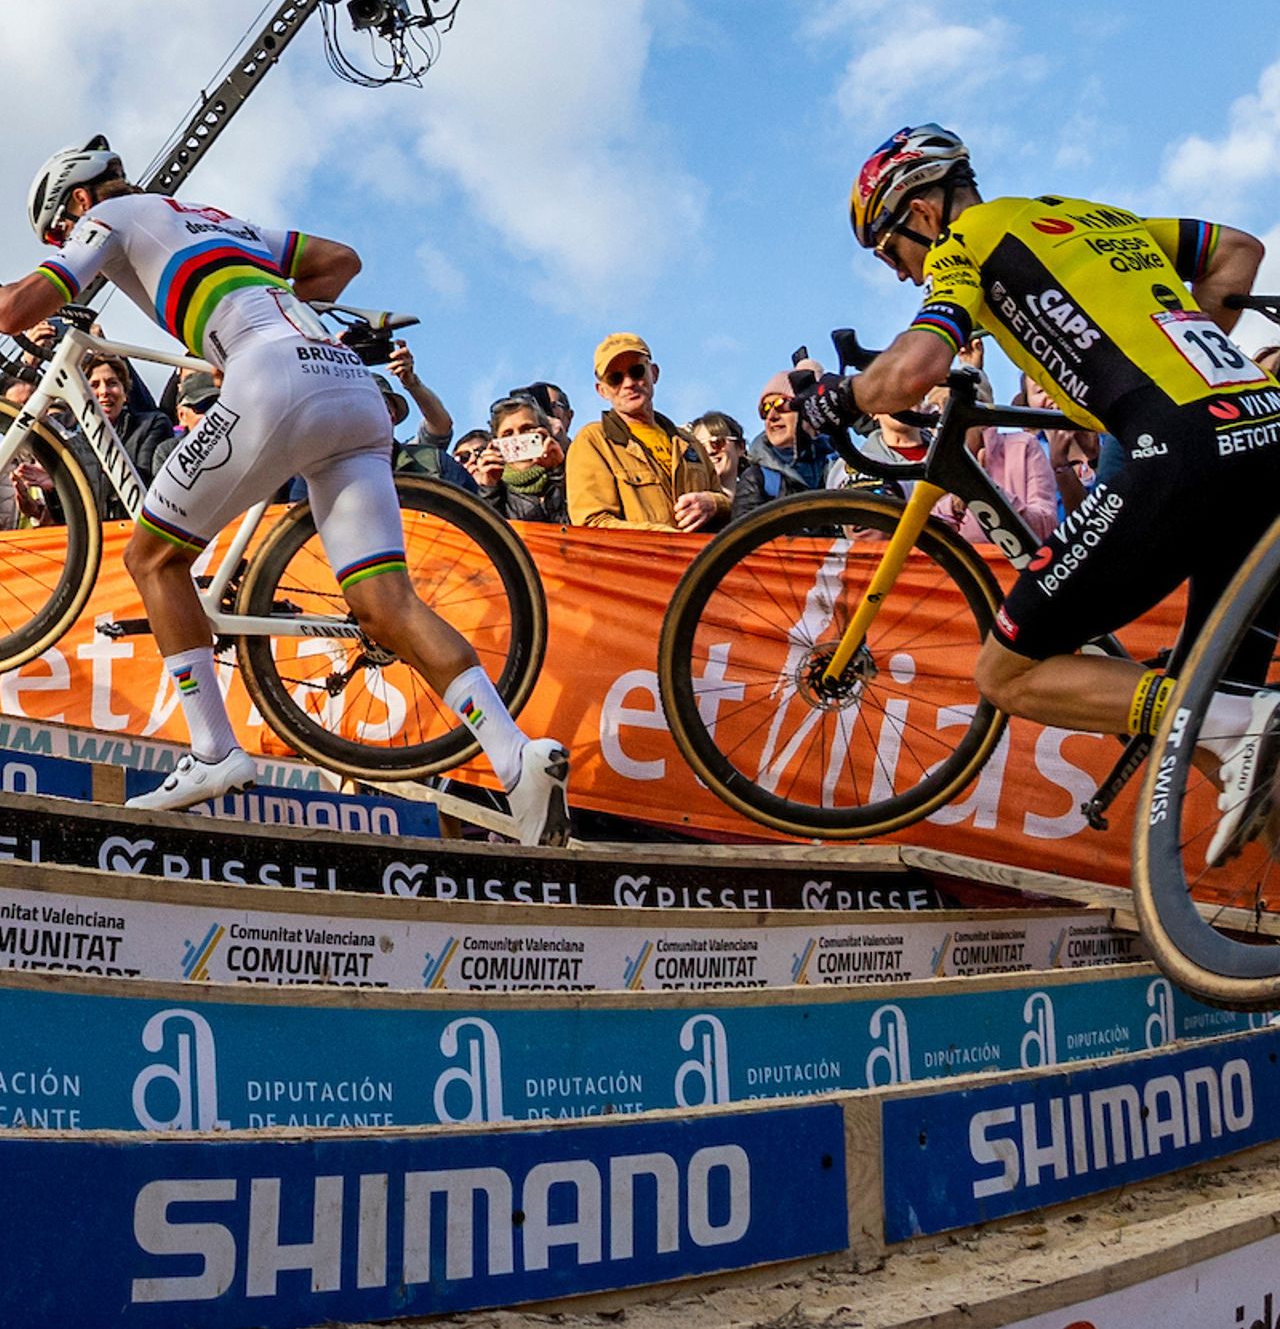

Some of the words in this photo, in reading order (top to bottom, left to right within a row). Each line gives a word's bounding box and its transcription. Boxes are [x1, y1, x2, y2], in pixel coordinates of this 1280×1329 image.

[44, 162, 77, 211] CANYON
[85, 229, 96, 245] 1
[1085, 236, 1150, 256] lease
[1040, 289, 1101, 350] CAPS
[296, 346, 361, 366] BRUSTO
[1001, 297, 1090, 407] BETCITY.NL
[1183, 329, 1245, 370] 13
[302, 363, 331, 376] SUN
[177, 411, 224, 474] Alpecin
[1131, 443, 1169, 460] AGU
[82, 398, 141, 514] CANYO
[1036, 543, 1089, 597] lease
[1167, 707, 1192, 749] DT
[1149, 755, 1177, 825] SWISS
[41, 907, 125, 931] Valenciana
[230, 924, 303, 944] Comunitat
[306, 929, 376, 948] Valenciana
[463, 936, 521, 953] Comunitat
[526, 938, 585, 954] Valenciana
[656, 938, 705, 953] Comunitat
[707, 939, 759, 953] Valenciana
[820, 935, 860, 948] Comunitat
[862, 935, 904, 947] Valenciana
[226, 945, 373, 979] COMUNITAT
[461, 956, 583, 981] COMUNITAT
[654, 956, 756, 980] COMUNITAT
[819, 950, 902, 973] COMUNITAT
[925, 1043, 1000, 1067] DIPUTACIÓN
[526, 1070, 643, 1098] DIPUTACIÓN
[747, 1058, 841, 1086] DIPUTACIÓN
[247, 1077, 393, 1103] DIPUTACIÓN
[968, 1057, 1253, 1200] SHIMANO
[131, 1145, 751, 1304] SHIMANO
